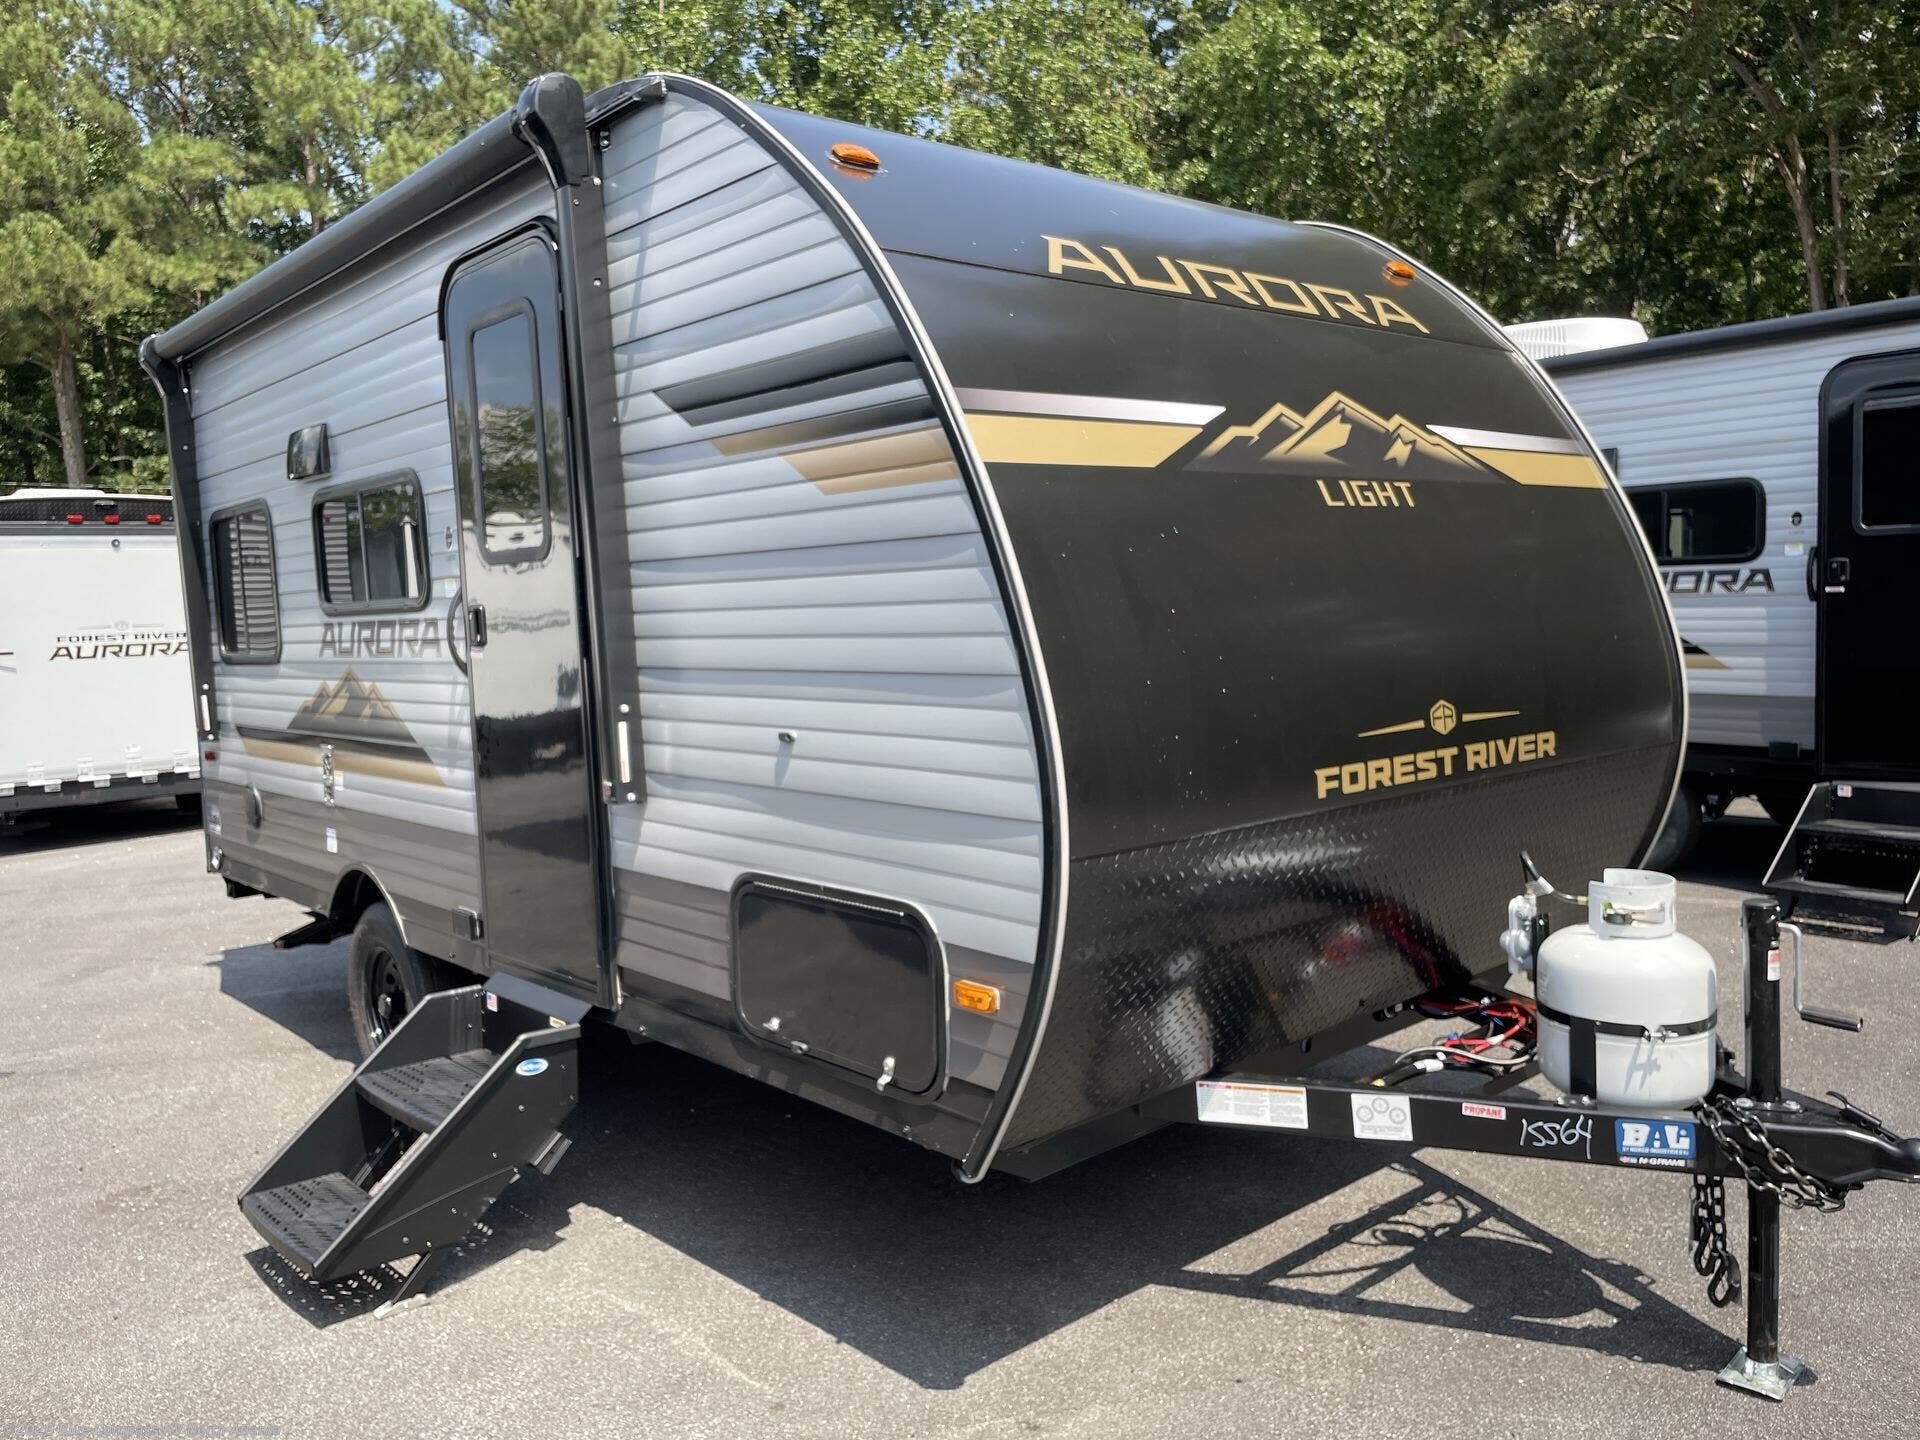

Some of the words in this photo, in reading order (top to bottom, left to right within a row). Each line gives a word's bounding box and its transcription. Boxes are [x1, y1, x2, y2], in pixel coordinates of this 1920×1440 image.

[1041, 234, 1430, 334] AURORA
[1315, 479, 1416, 508] LIGHT
[56, 633, 126, 643] FOREST
[134, 631, 187, 640] RIVER
[319, 617, 442, 658] AURORA
[1314, 746, 1459, 799] FOREST
[1464, 730, 1557, 771] RIVER
[1464, 1105, 1502, 1118] PROPANE
[1621, 1122, 1690, 1150] BAL
